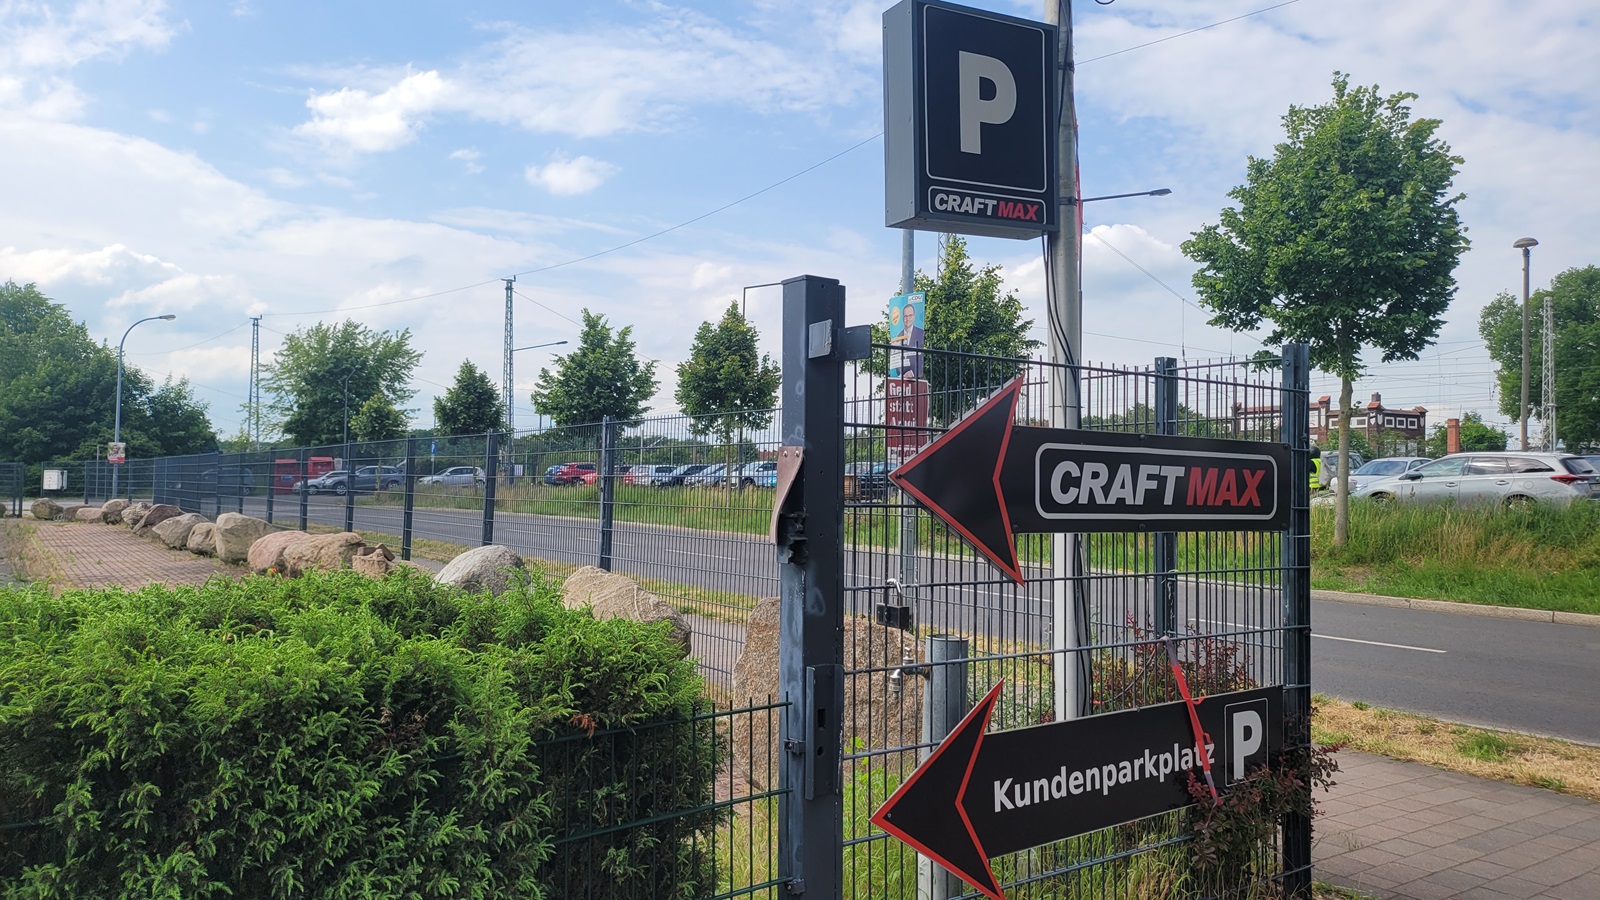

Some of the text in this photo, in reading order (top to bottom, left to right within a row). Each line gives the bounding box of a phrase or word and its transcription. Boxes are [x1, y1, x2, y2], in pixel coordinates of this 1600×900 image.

[958, 50, 1017, 155] P
[889, 382, 912, 396] Geld
[1232, 710, 1263, 781] P
